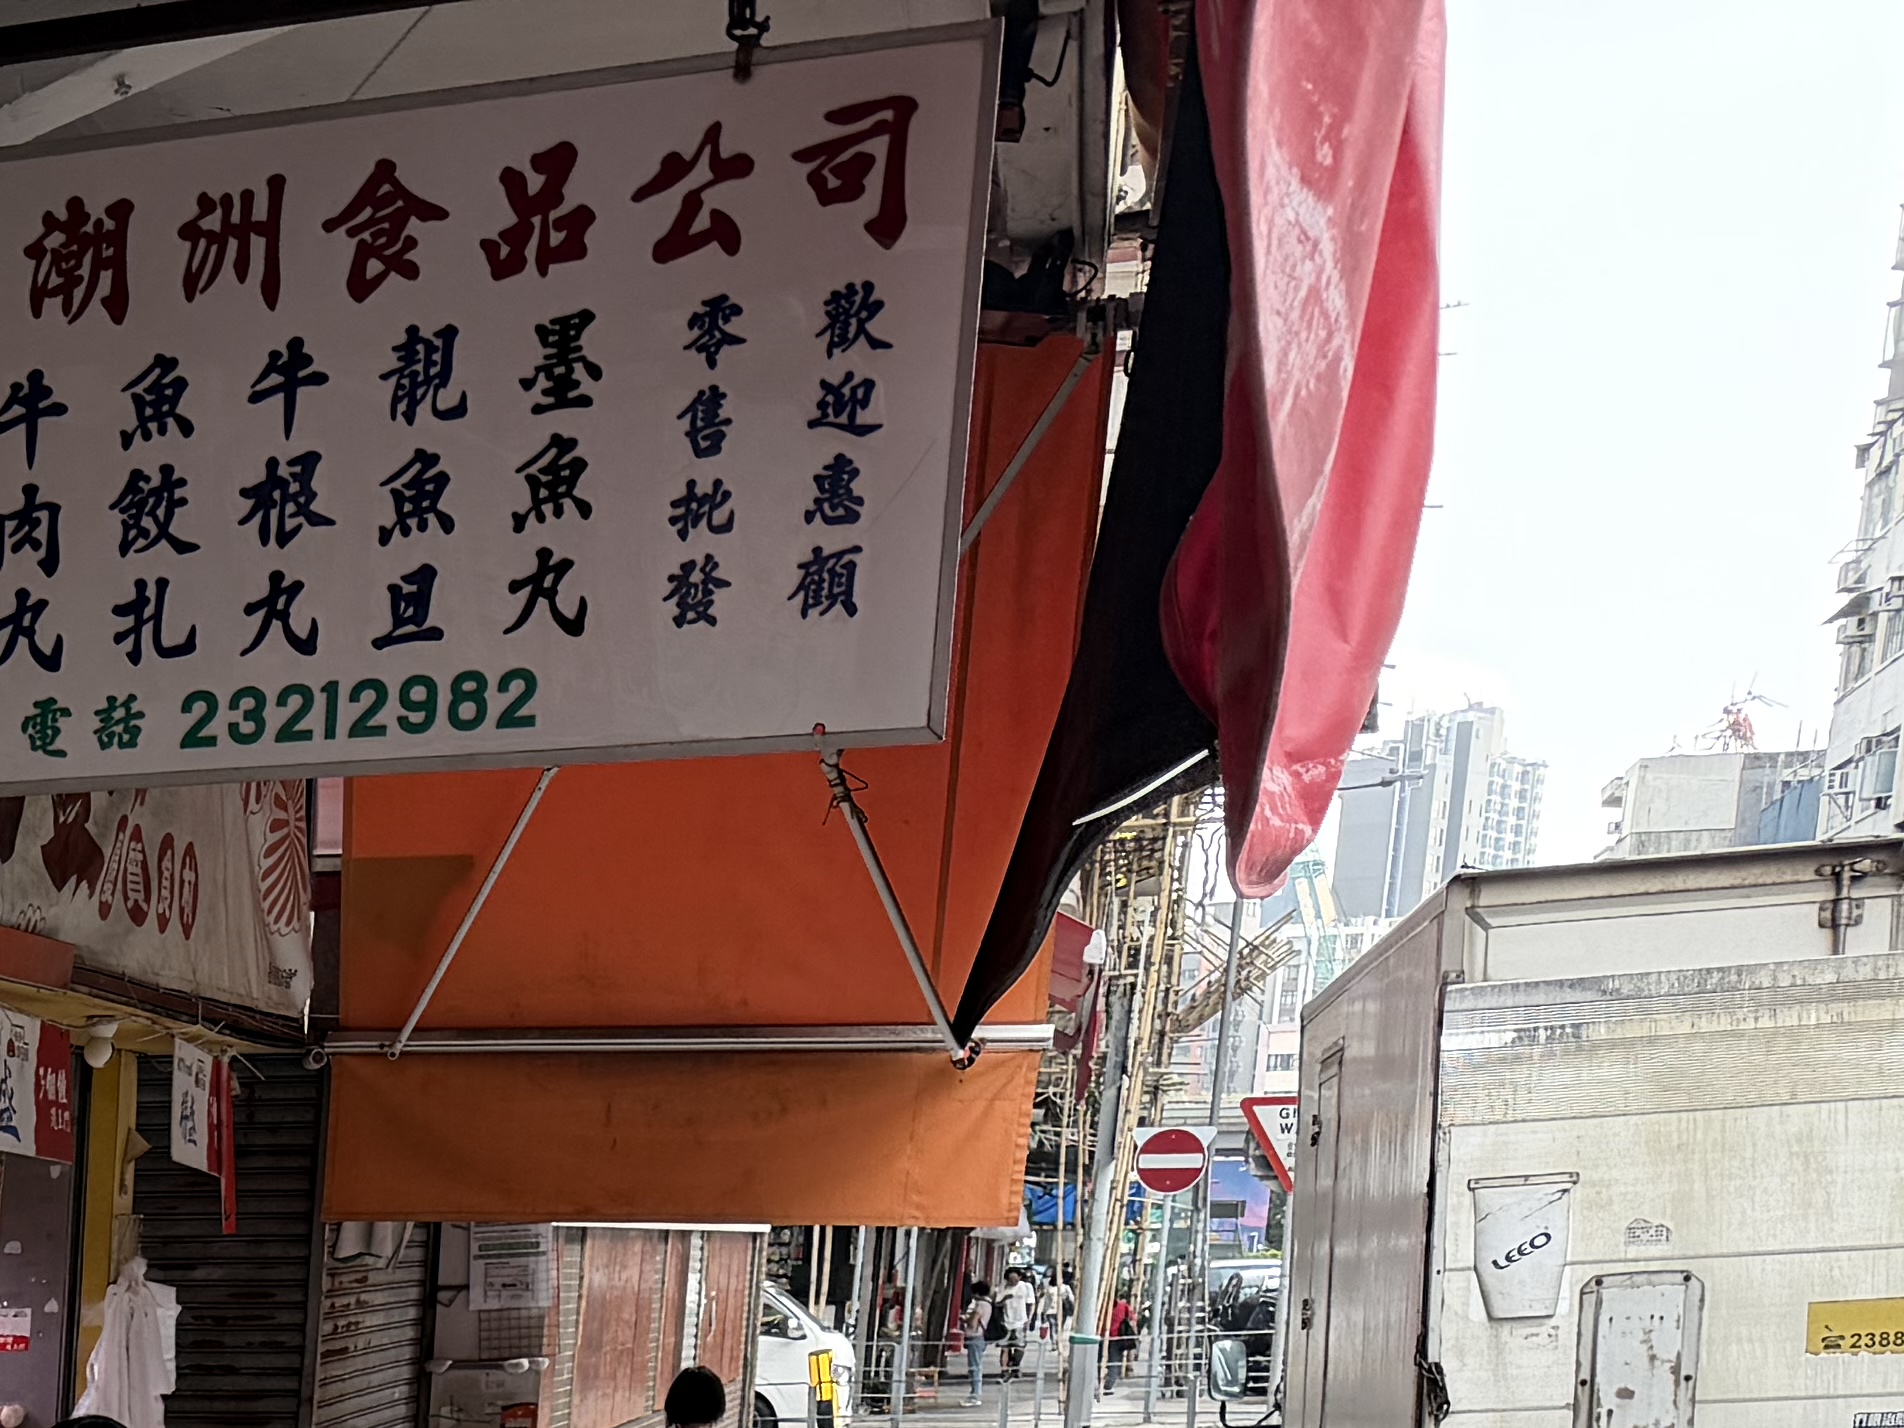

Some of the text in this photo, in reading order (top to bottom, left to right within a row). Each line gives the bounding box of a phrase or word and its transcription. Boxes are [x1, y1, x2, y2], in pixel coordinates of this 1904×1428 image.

[109, 352, 202, 665] 魚餃扎
[238, 337, 337, 658] 牛根丸
[375, 325, 469, 653] 靚魚旦
[503, 308, 604, 638] 墨魚丸
[661, 293, 752, 629] 零售批發
[787, 279, 894, 623] 歡迎惠顧
[19, 667, 539, 758] 電話 23212982
[1492, 1231, 1552, 1271] LEEO
